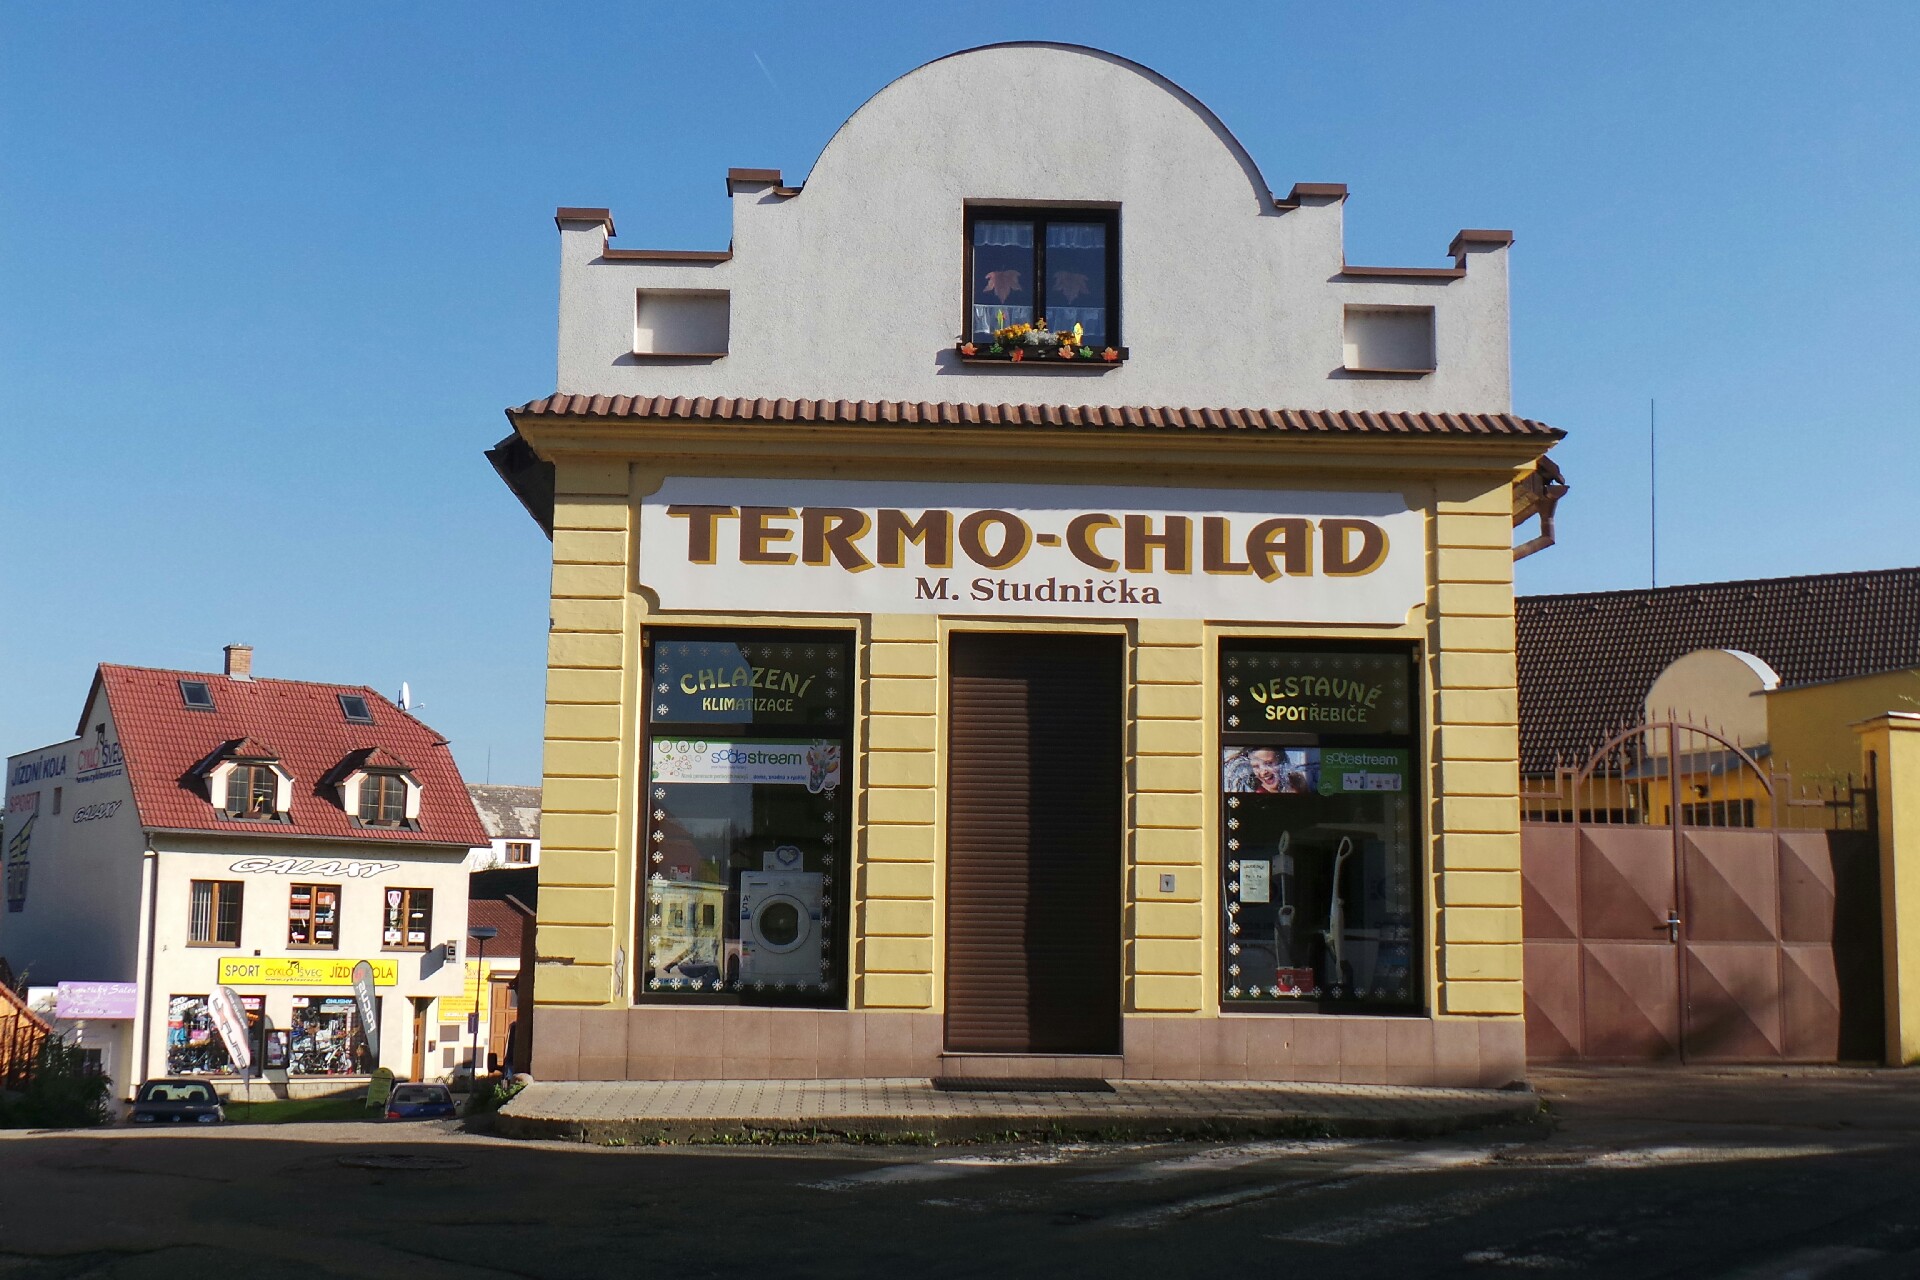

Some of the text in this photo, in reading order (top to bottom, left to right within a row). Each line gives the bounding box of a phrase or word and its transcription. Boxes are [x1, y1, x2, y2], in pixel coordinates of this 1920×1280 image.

[666, 504, 1390, 584] TERMO-CHLAD
[915, 577, 1162, 604] M. Studnička
[680, 666, 816, 698] CHLAZENÍ
[1250, 676, 1382, 709] VESTAVNÉ
[702, 697, 794, 712] KLIMATIZACE
[1265, 702, 1367, 722] SPOTŘEBIČE
[711, 748, 802, 766] sodastream
[12, 754, 66, 787] JÍZDNÍ KOLA
[73, 800, 122, 823] GALAXY
[229, 857, 400, 879] GALAXY
[225, 964, 260, 977] SPORT
[265, 966, 322, 977] CYKLO ŠVEC
[329, 962, 394, 979] JÍZD OLA
